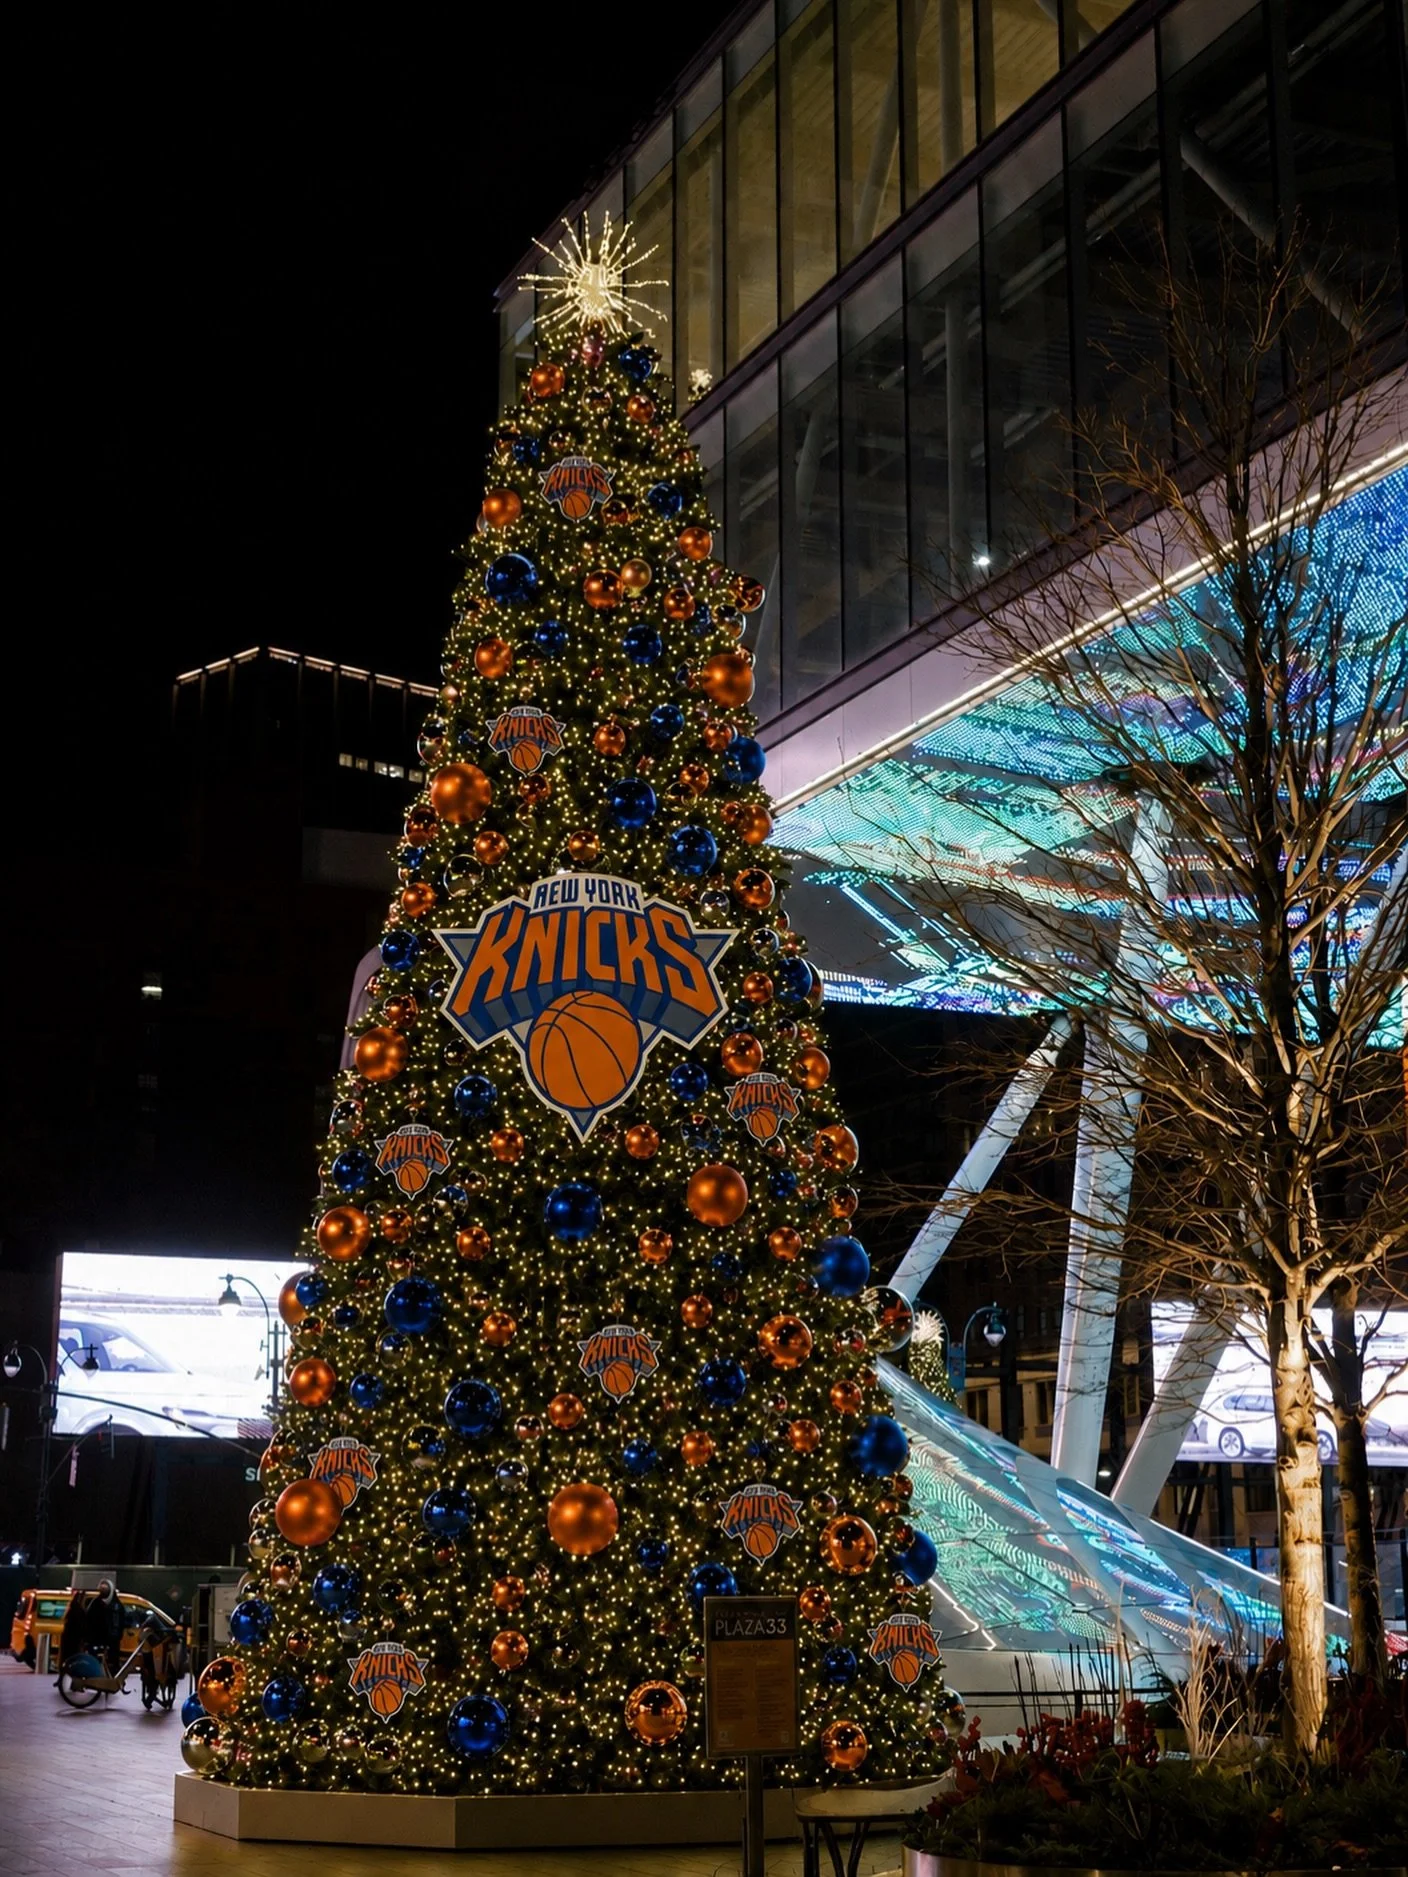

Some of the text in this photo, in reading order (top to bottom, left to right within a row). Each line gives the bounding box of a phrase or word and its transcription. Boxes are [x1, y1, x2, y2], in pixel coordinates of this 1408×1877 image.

[533, 878, 642, 911] NEW YORK
[450, 903, 720, 1019] KNICKS
[379, 1134, 449, 1168] KNICKS
[583, 1335, 656, 1369] KNICKS
[725, 1495, 797, 1530] KNICKS
[351, 1652, 423, 1687] KNICKS
